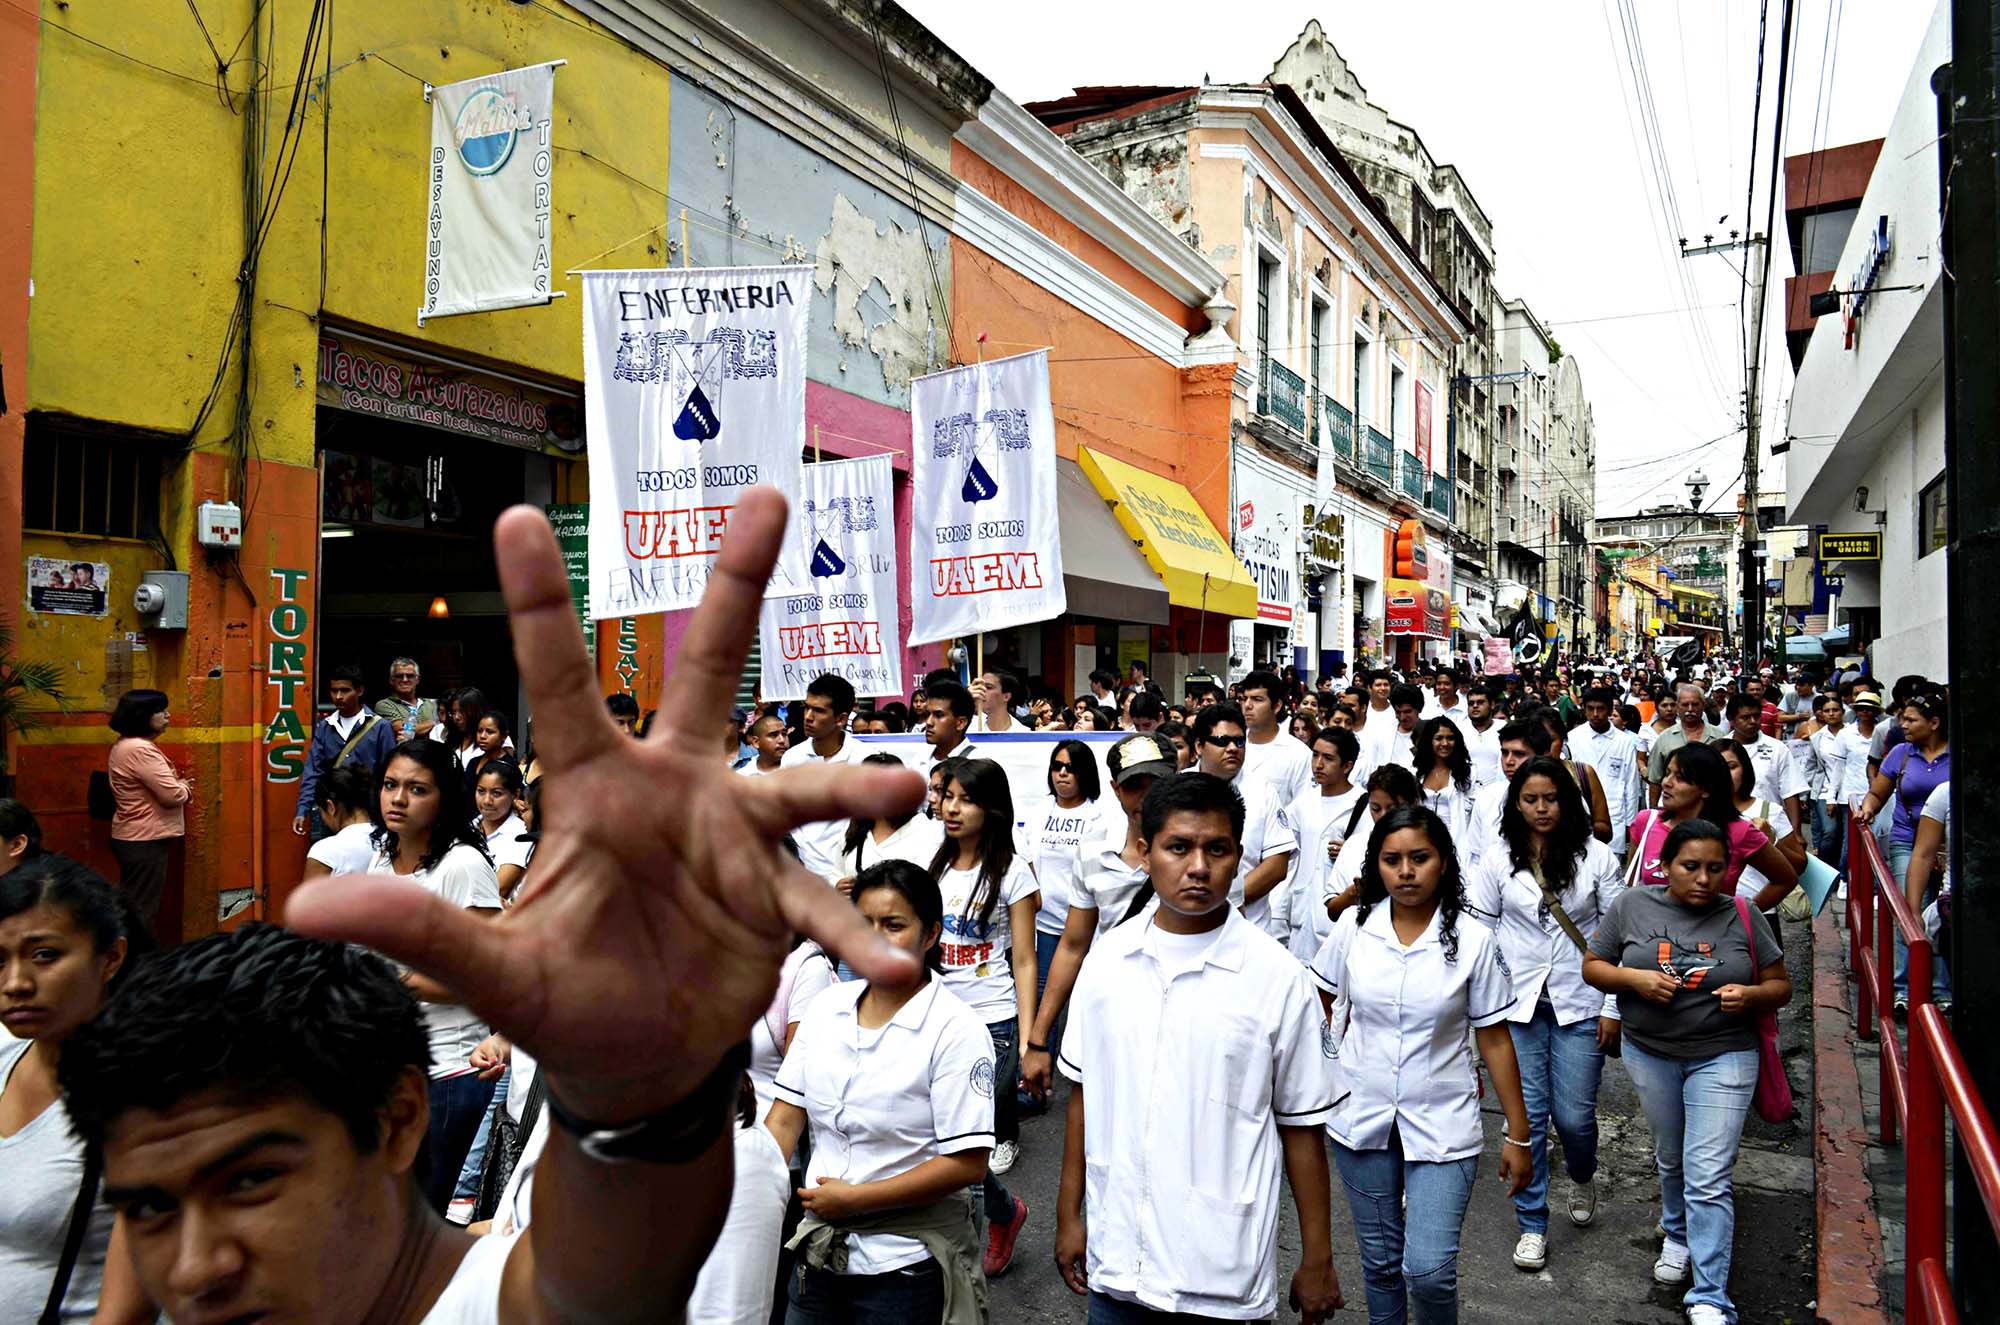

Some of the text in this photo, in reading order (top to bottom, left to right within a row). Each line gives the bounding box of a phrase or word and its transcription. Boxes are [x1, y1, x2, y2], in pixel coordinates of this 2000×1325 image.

[427, 146, 446, 313] DESAYUNOS
[533, 119, 551, 299] TORTAS
[618, 280, 794, 322] ENFERMERIA
[319, 337, 548, 433] Tacos Acorazados
[341, 389, 381, 413] (Con
[383, 398, 442, 425] tortillas
[637, 465, 758, 492] TODOS SOMOS
[624, 504, 738, 560] UAE
[936, 520, 1024, 543] TODOS SOMOS
[930, 552, 1043, 597] UAEM
[788, 594, 868, 615] TODOS SOMOS
[779, 621, 881, 661] UAEM
[263, 568, 308, 784] TORTAS
